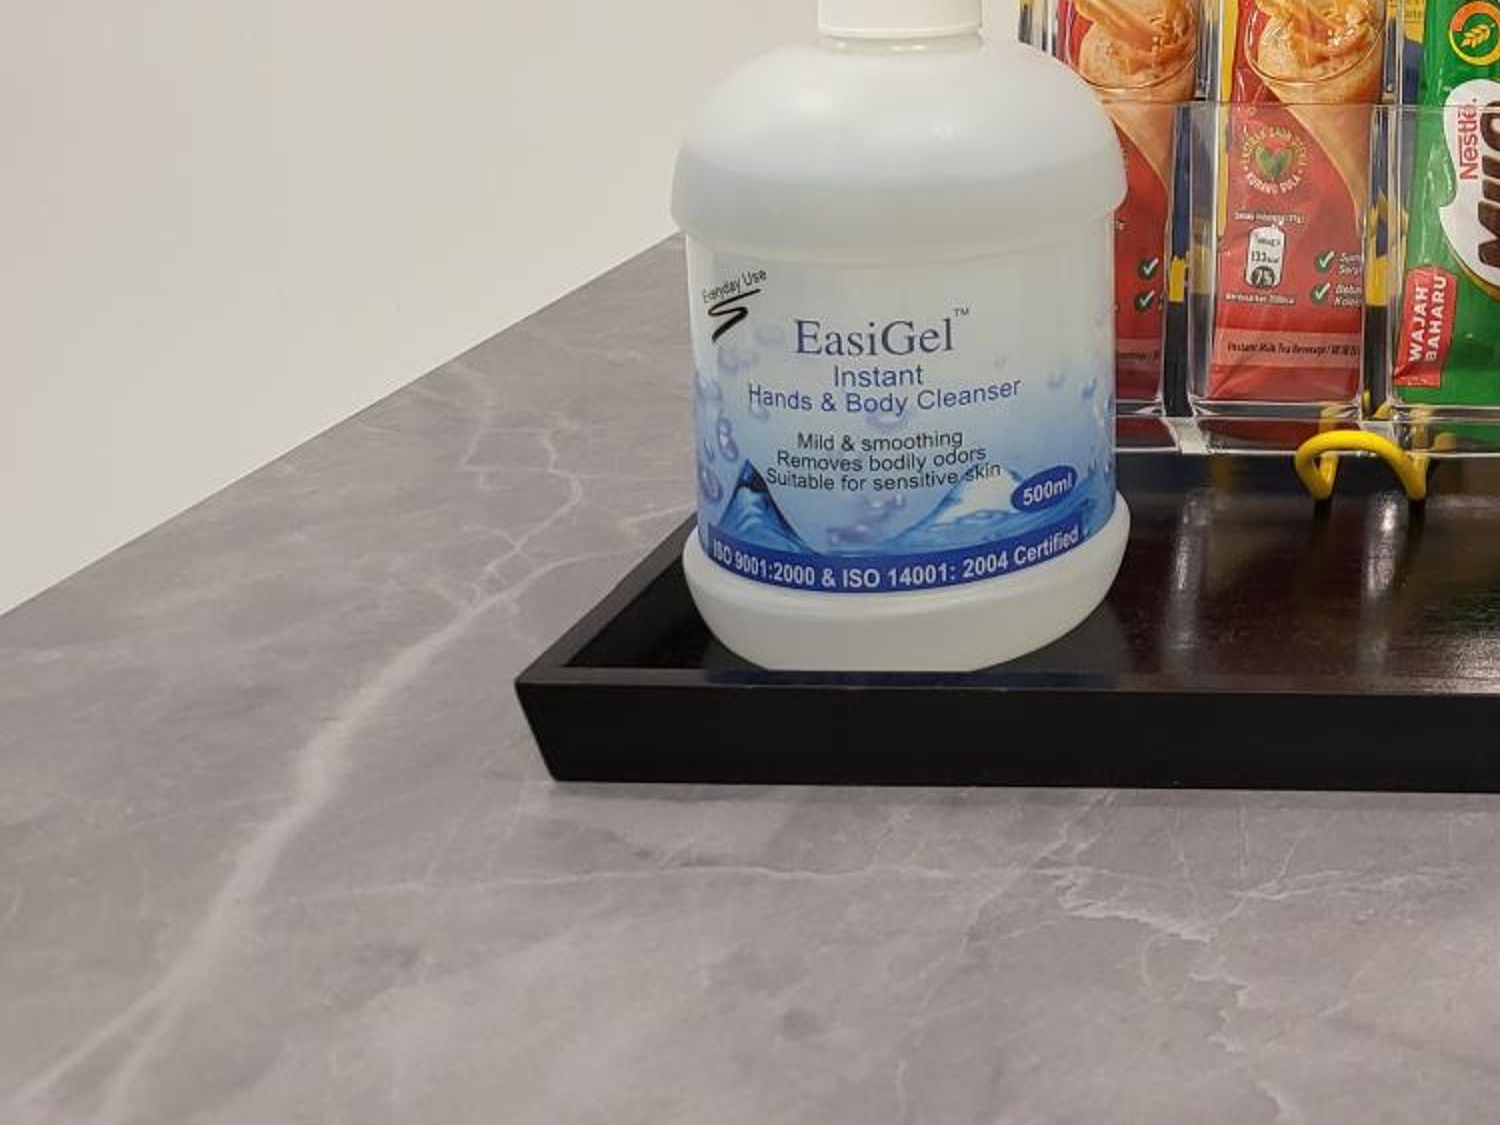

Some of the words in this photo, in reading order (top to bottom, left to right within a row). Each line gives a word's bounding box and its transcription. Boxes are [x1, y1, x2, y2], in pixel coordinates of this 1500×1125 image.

[741, 270, 767, 286] Use
[1408, 283, 1428, 362] WAJAH
[1425, 275, 1447, 362] BAHARU
[794, 318, 954, 356] EasiGel
[833, 364, 924, 387] Instant
[749, 382, 813, 412] Hands
[821, 391, 837, 412] &
[846, 391, 908, 416] Body
[917, 379, 1022, 410] Cleanser
[797, 432, 835, 452] Mild
[841, 435, 855, 452] &
[861, 431, 963, 452] smoothing
[766, 467, 835, 491] Suitable
[841, 472, 867, 491] for
[873, 468, 960, 491] sensitive
[965, 461, 1002, 482] skin
[777, 450, 862, 472] Removes
[869, 453, 926, 475] bodily
[934, 446, 987, 467] odors
[1022, 474, 1073, 507] 500ml
[712, 538, 733, 565] ISO
[735, 550, 816, 586] 9001:2000
[821, 568, 837, 588] &
[843, 568, 881, 588] ISO
[887, 563, 956, 586] 14001:
[963, 551, 1009, 579] 2004
[1013, 523, 1080, 565] Certified
